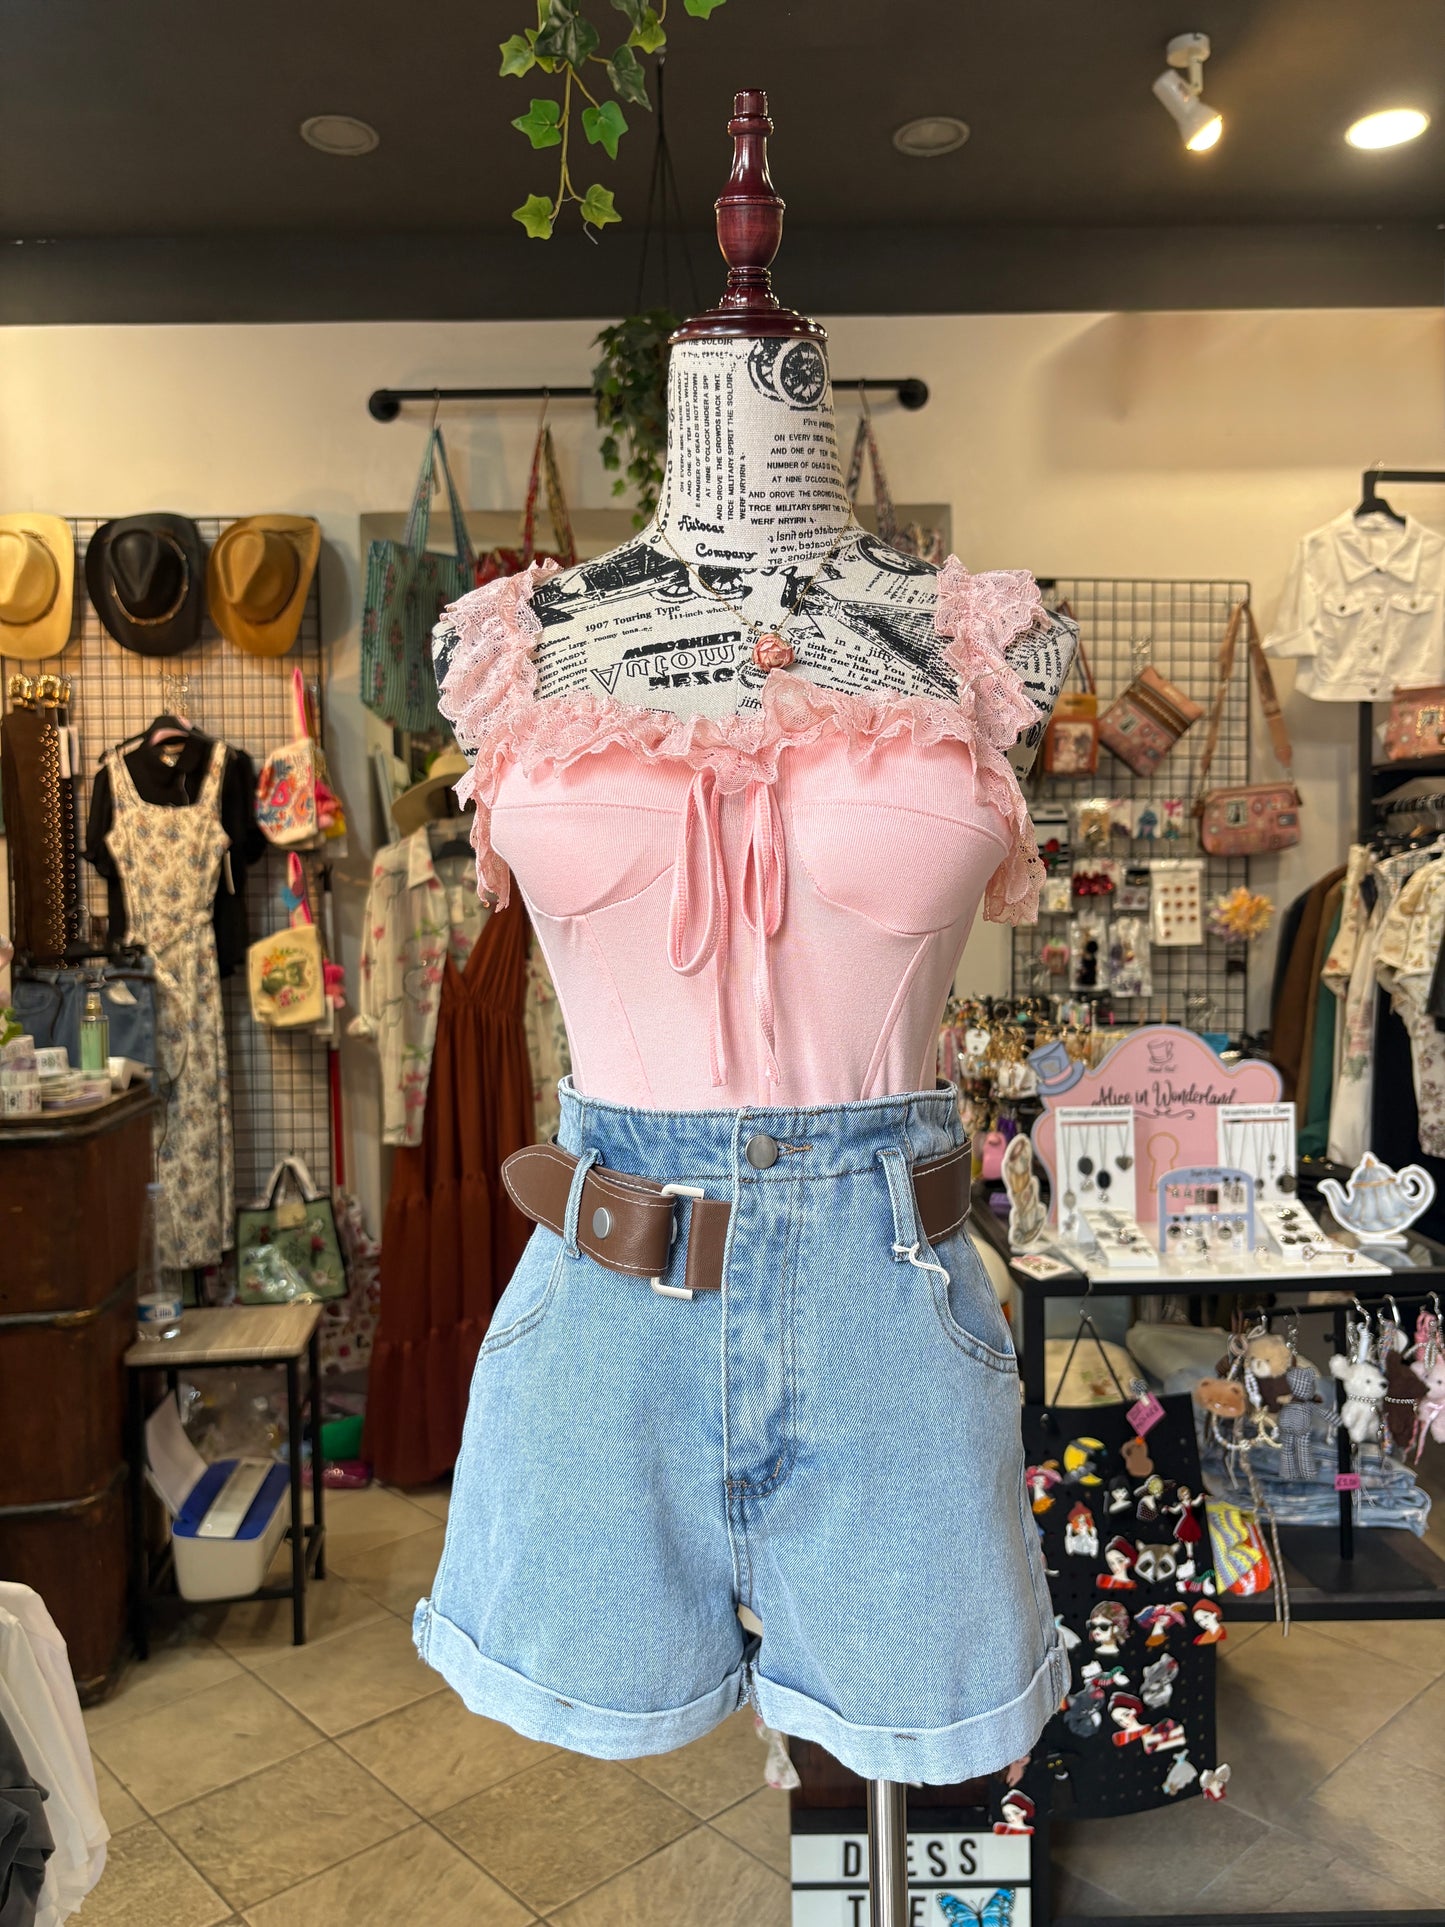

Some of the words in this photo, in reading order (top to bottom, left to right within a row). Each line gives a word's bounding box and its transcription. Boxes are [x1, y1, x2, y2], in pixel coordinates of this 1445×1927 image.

[774, 434, 785, 443] ON
[789, 434, 811, 442] EVERY
[770, 447, 787, 456] AND
[790, 447, 805, 455] ONE
[766, 461, 799, 470] NUMBER
[772, 475, 782, 484] AT
[705, 487, 711, 498] AT
[748, 491, 766, 499] AND
[799, 490, 811, 498] THE
[749, 504, 772, 512] TRCE
[776, 503, 811, 512] MILITARY
[750, 517, 775, 526] WERF
[695, 542, 758, 562] Company
[585, 620, 609, 633] 1907
[612, 611, 652, 626] Touring
[654, 604, 681, 617] Type
[834, 637, 846, 647] in
[789, 636, 801, 646] to
[806, 641, 838, 656] tinker
[845, 652, 871, 666] with.
[882, 662, 905, 677] You
[804, 650, 827, 662] with
[830, 657, 850, 668] one
[852, 662, 879, 676] hand
[883, 674, 906, 686] puts
[911, 682, 919, 691] it
[847, 669, 857, 679] It
[860, 673, 869, 682] is
[541, 680, 557, 691] NOT
[557, 667, 588, 683] KNOWN
[1092, 1085, 1132, 1107] Alice
[1135, 1088, 1149, 1107] in
[1152, 1079, 1237, 1108] Wonderland
[842, 1838, 978, 1878] DESS
[848, 1894, 927, 1927] TE
